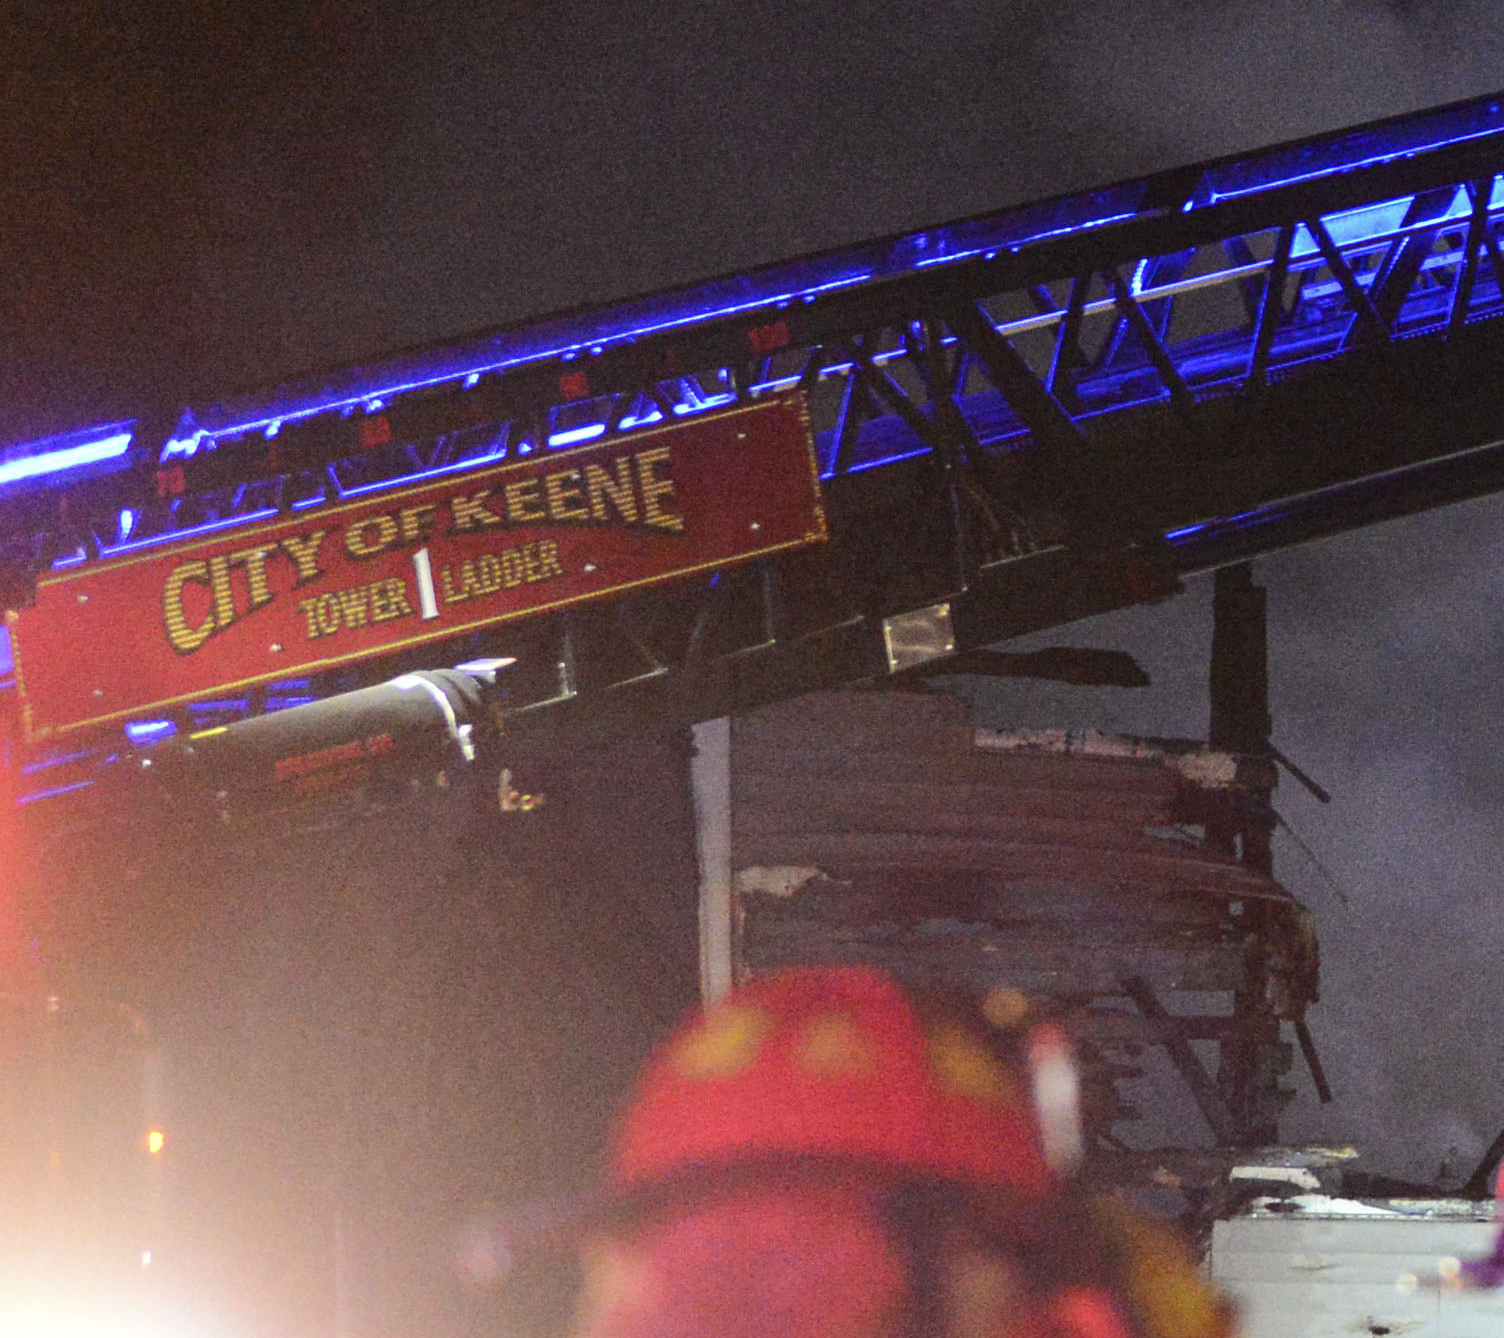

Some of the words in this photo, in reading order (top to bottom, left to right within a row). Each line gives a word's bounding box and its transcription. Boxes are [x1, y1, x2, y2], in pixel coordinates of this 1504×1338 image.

[163, 531, 328, 653] CITY
[344, 504, 438, 558] OF
[448, 446, 686, 533] KEENE
[300, 576, 414, 640] TOWER
[442, 539, 564, 606] LADDER
